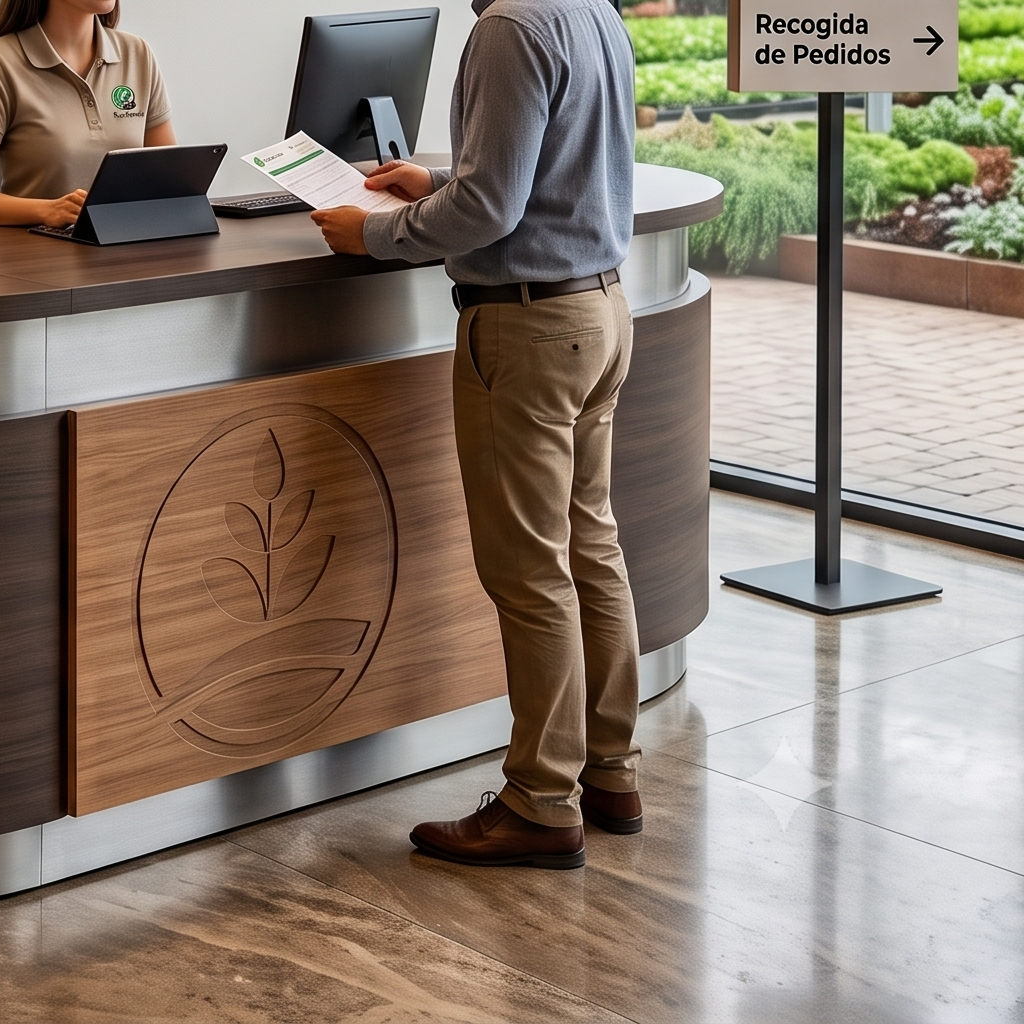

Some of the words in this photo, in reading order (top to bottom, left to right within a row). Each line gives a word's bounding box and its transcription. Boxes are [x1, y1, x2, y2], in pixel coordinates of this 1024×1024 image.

[756, 12, 869, 39] Recogida
[755, 43, 786, 65] de
[793, 42, 891, 65] Pedidos
